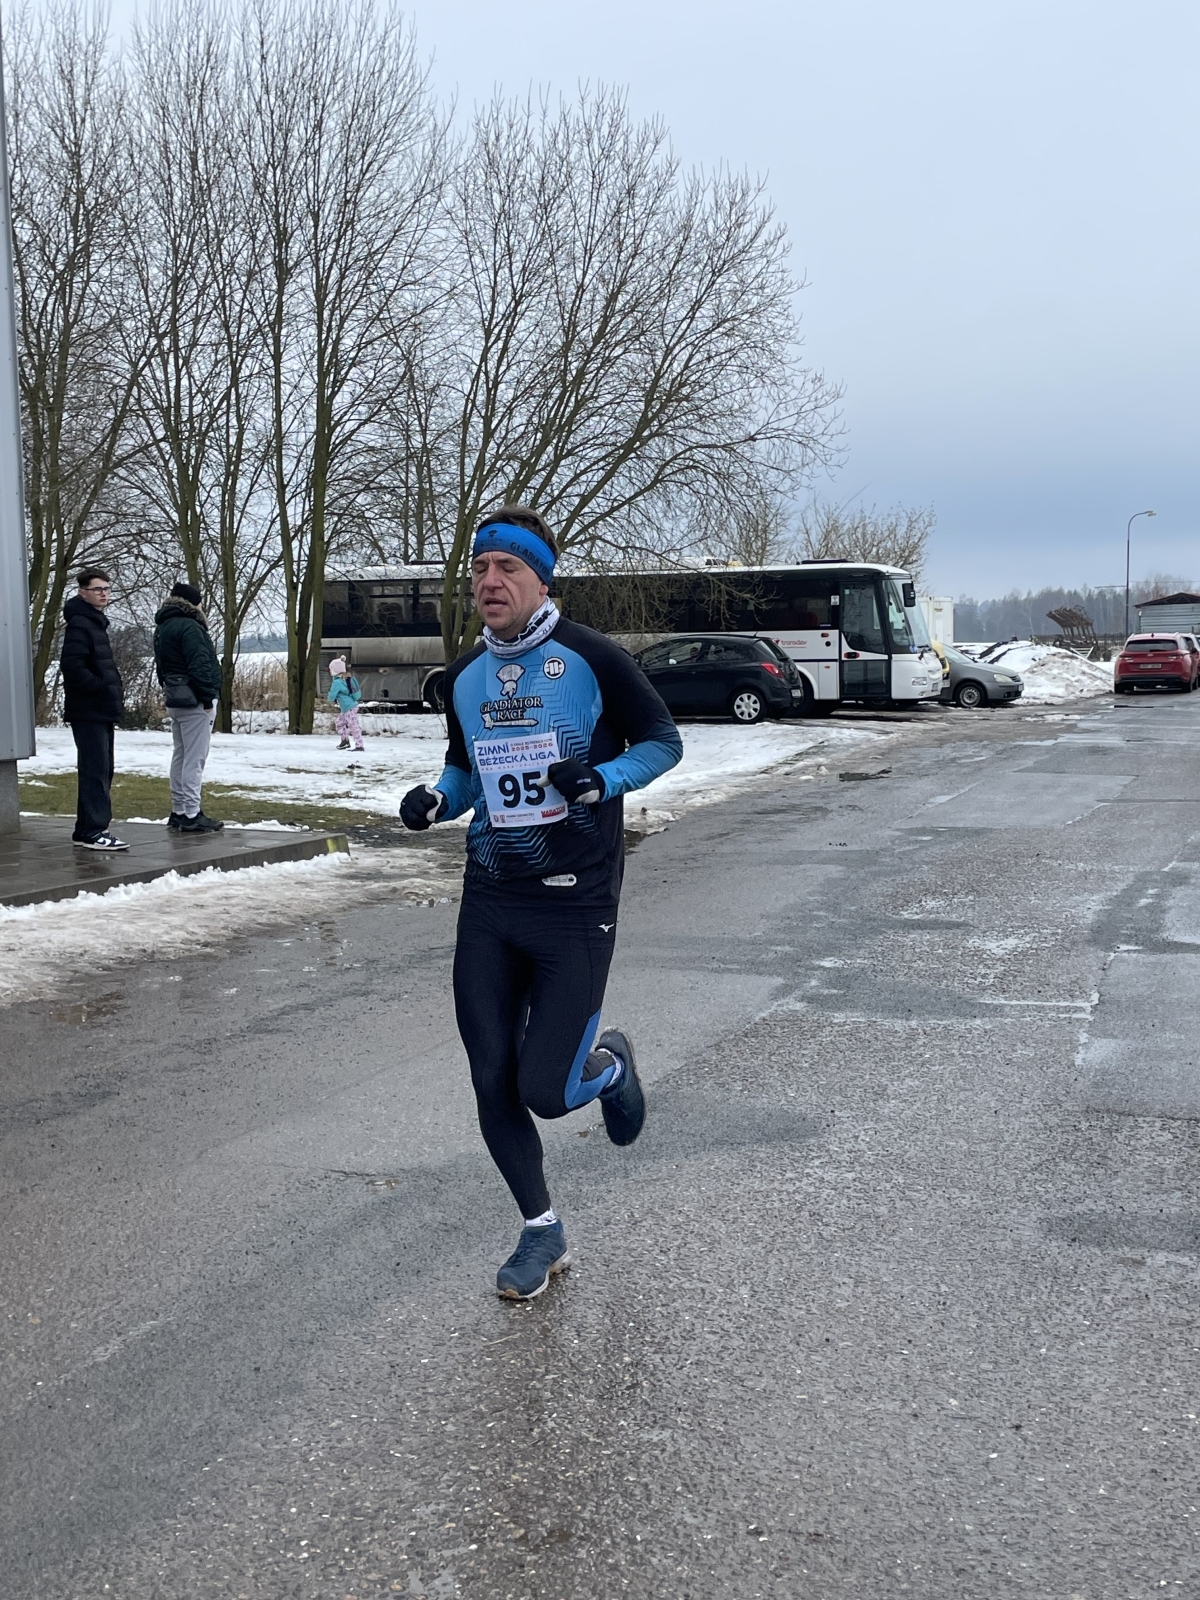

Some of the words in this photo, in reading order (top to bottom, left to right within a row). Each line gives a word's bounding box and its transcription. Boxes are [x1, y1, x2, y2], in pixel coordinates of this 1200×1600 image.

[480, 697, 542, 713] GLADIATOR
[497, 709, 524, 720] RACE
[477, 742, 510, 757] ZIMNÍ
[511, 742, 554, 752] 2025-2026
[479, 753, 528, 767] BĚŽECKÁ
[529, 750, 556, 762] LIGA
[498, 771, 546, 808] 95
